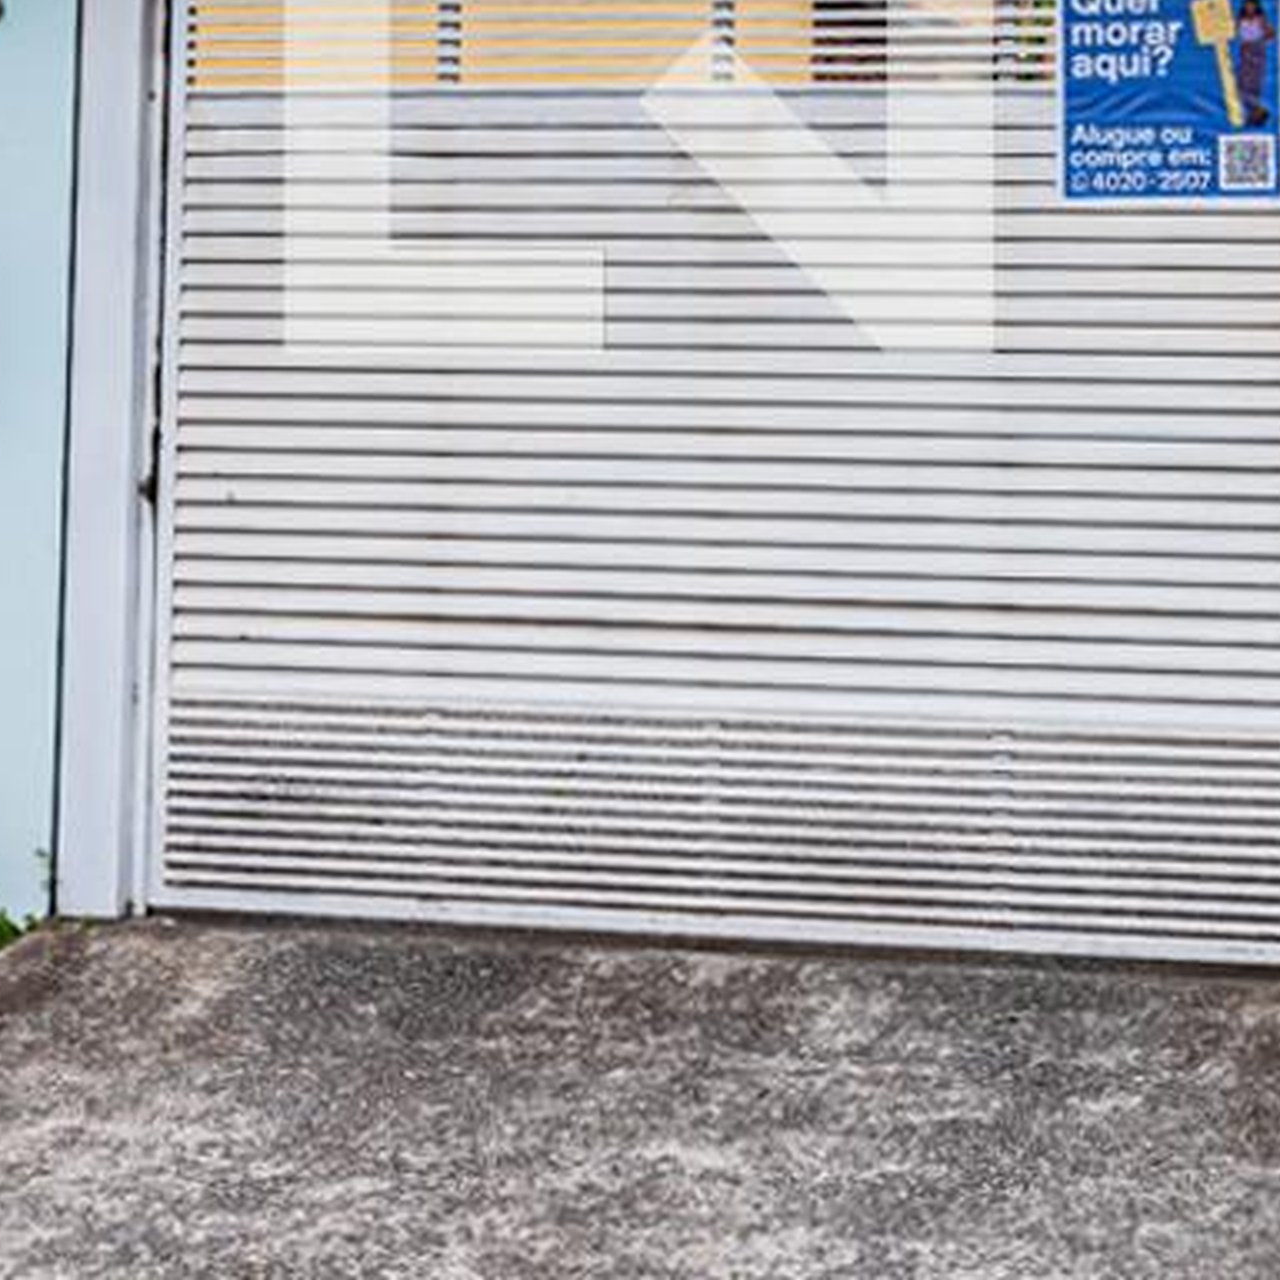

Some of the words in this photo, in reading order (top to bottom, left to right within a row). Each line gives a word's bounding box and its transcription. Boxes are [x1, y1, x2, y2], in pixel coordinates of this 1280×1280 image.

[1071, 21, 1182, 46] morar
[1071, 47, 1173, 84] aqui?
[1070, 124, 1155, 149] Alugue
[1160, 127, 1193, 145] ou
[1069, 148, 1163, 171] compre
[1167, 149, 1212, 167] em:
